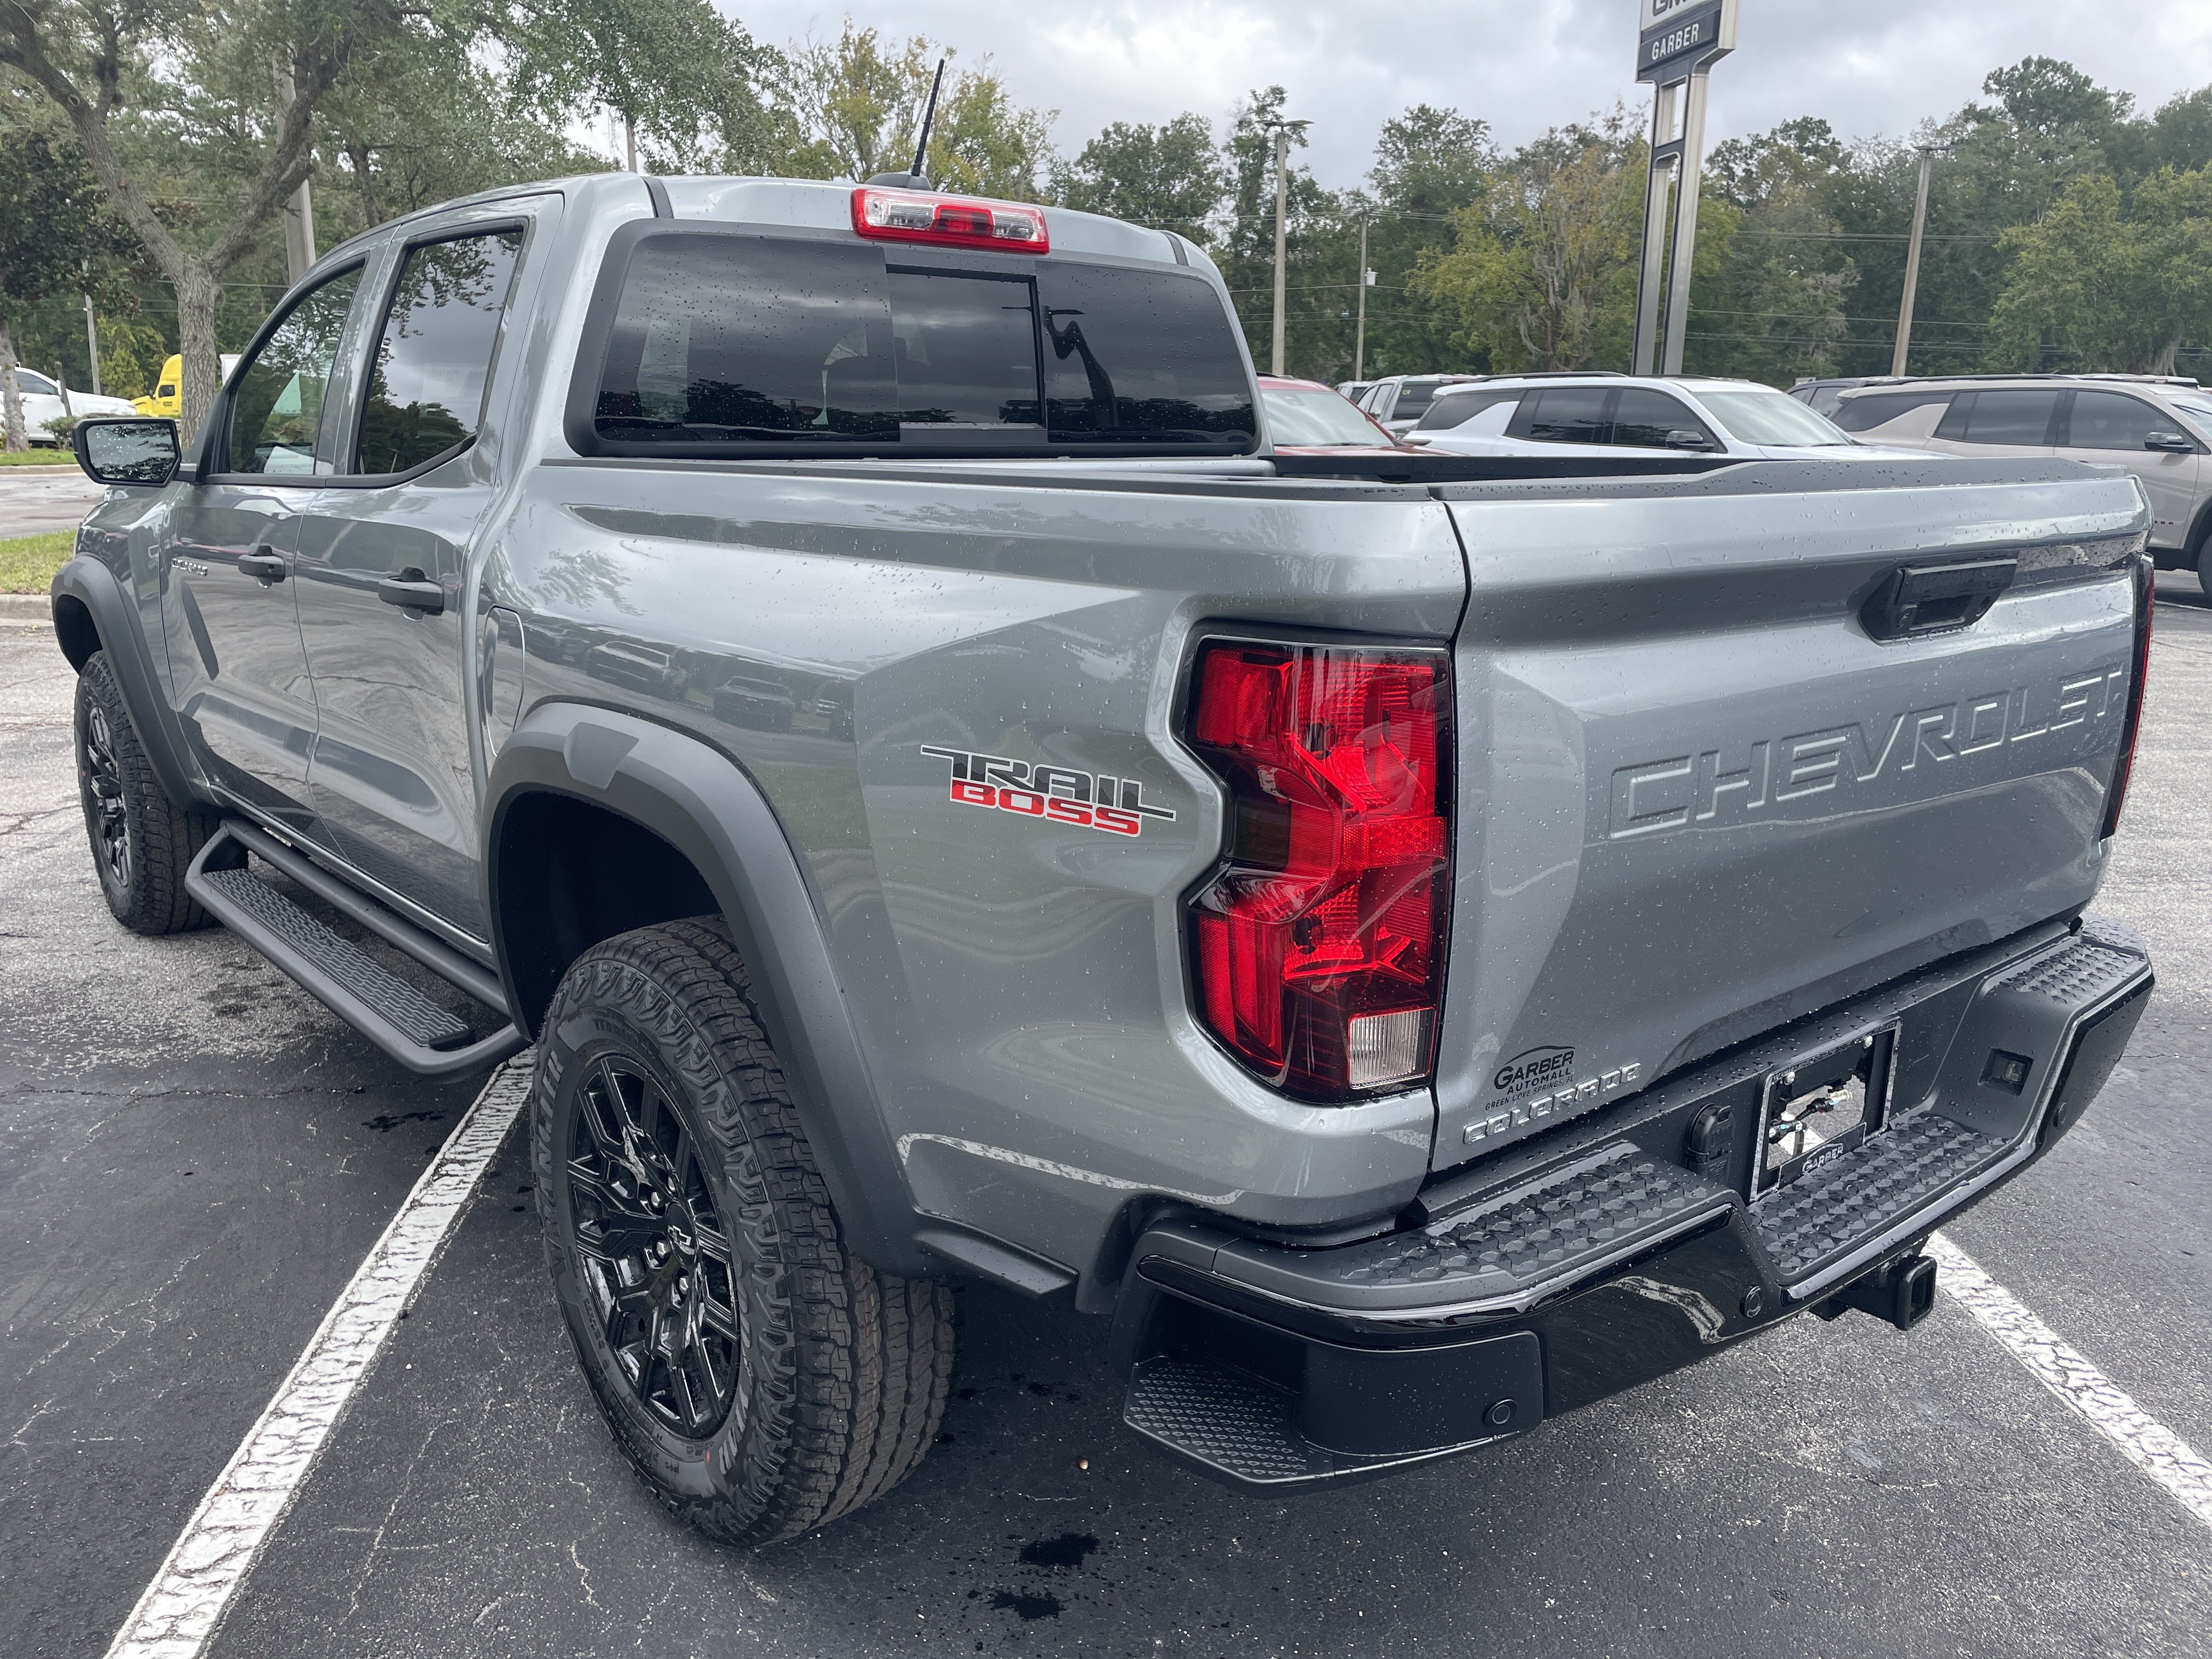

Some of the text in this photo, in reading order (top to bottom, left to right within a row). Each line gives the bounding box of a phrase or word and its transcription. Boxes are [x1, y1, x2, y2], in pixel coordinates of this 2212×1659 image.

[1651, 23, 1700, 61] GARBER
[1609, 663, 2122, 839] CHEVROLET
[921, 744, 1177, 822] TRAIL
[950, 778, 1142, 838] BOSS
[1494, 1051, 1575, 1090] GARBER
[1506, 1067, 1571, 1095] AUTOMALL
[1463, 1062, 1641, 1144] COLORADO
[1485, 1098, 1509, 1110] GREEN
[1512, 1090, 1531, 1102] COVE
[1566, 1075, 1573, 1085] FL
[1802, 1146, 1844, 1175] GARBER
